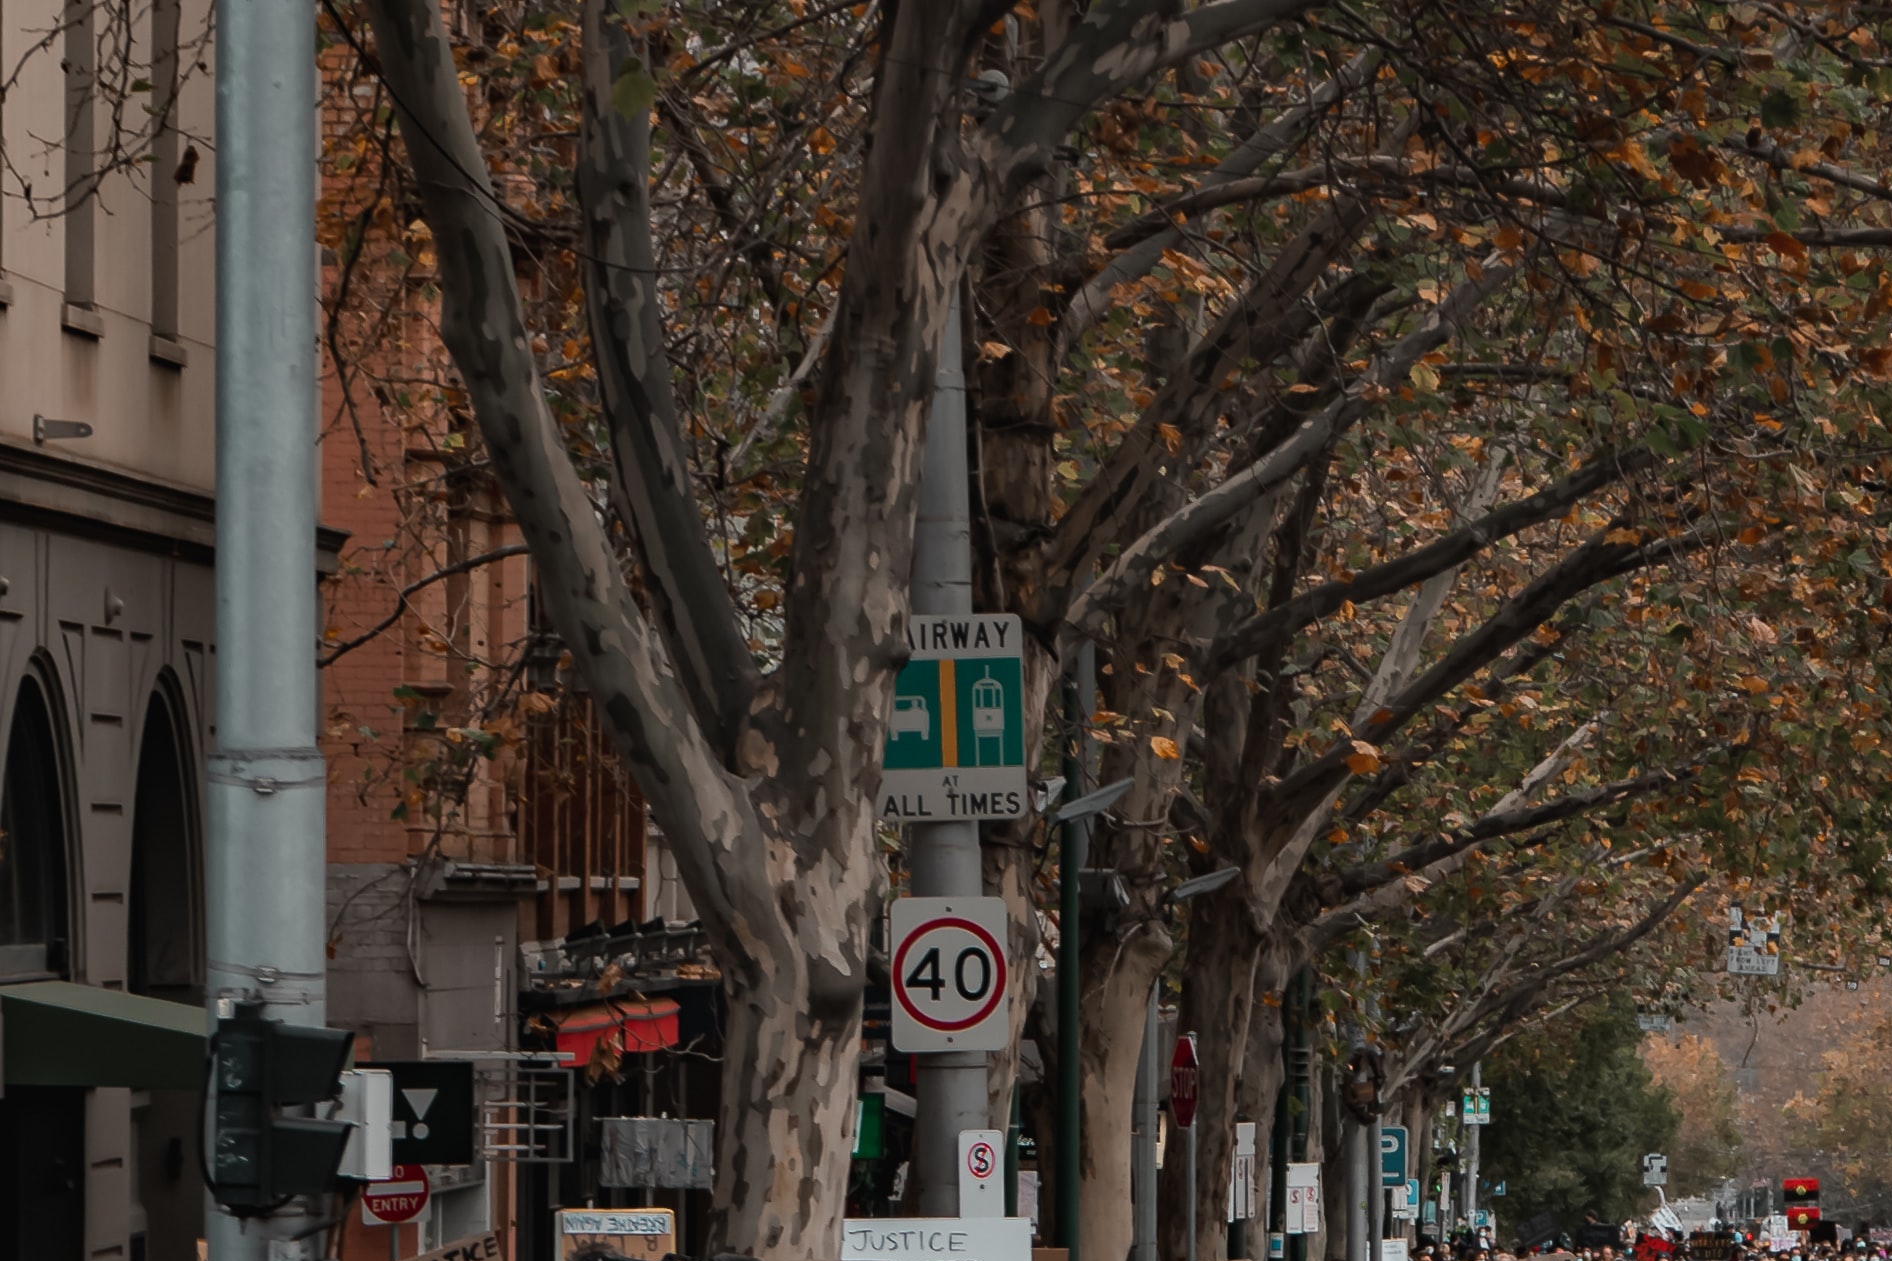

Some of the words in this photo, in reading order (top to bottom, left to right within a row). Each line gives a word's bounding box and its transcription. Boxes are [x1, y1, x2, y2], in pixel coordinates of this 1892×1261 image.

[942, 774, 960, 788] AT
[882, 794, 933, 818] ALL
[946, 791, 1022, 816] TIMES
[904, 946, 992, 1003] 40
[1172, 1067, 1197, 1100] STOP
[372, 1197, 420, 1213] ENTRY
[848, 1228, 968, 1252] JUSTICE
